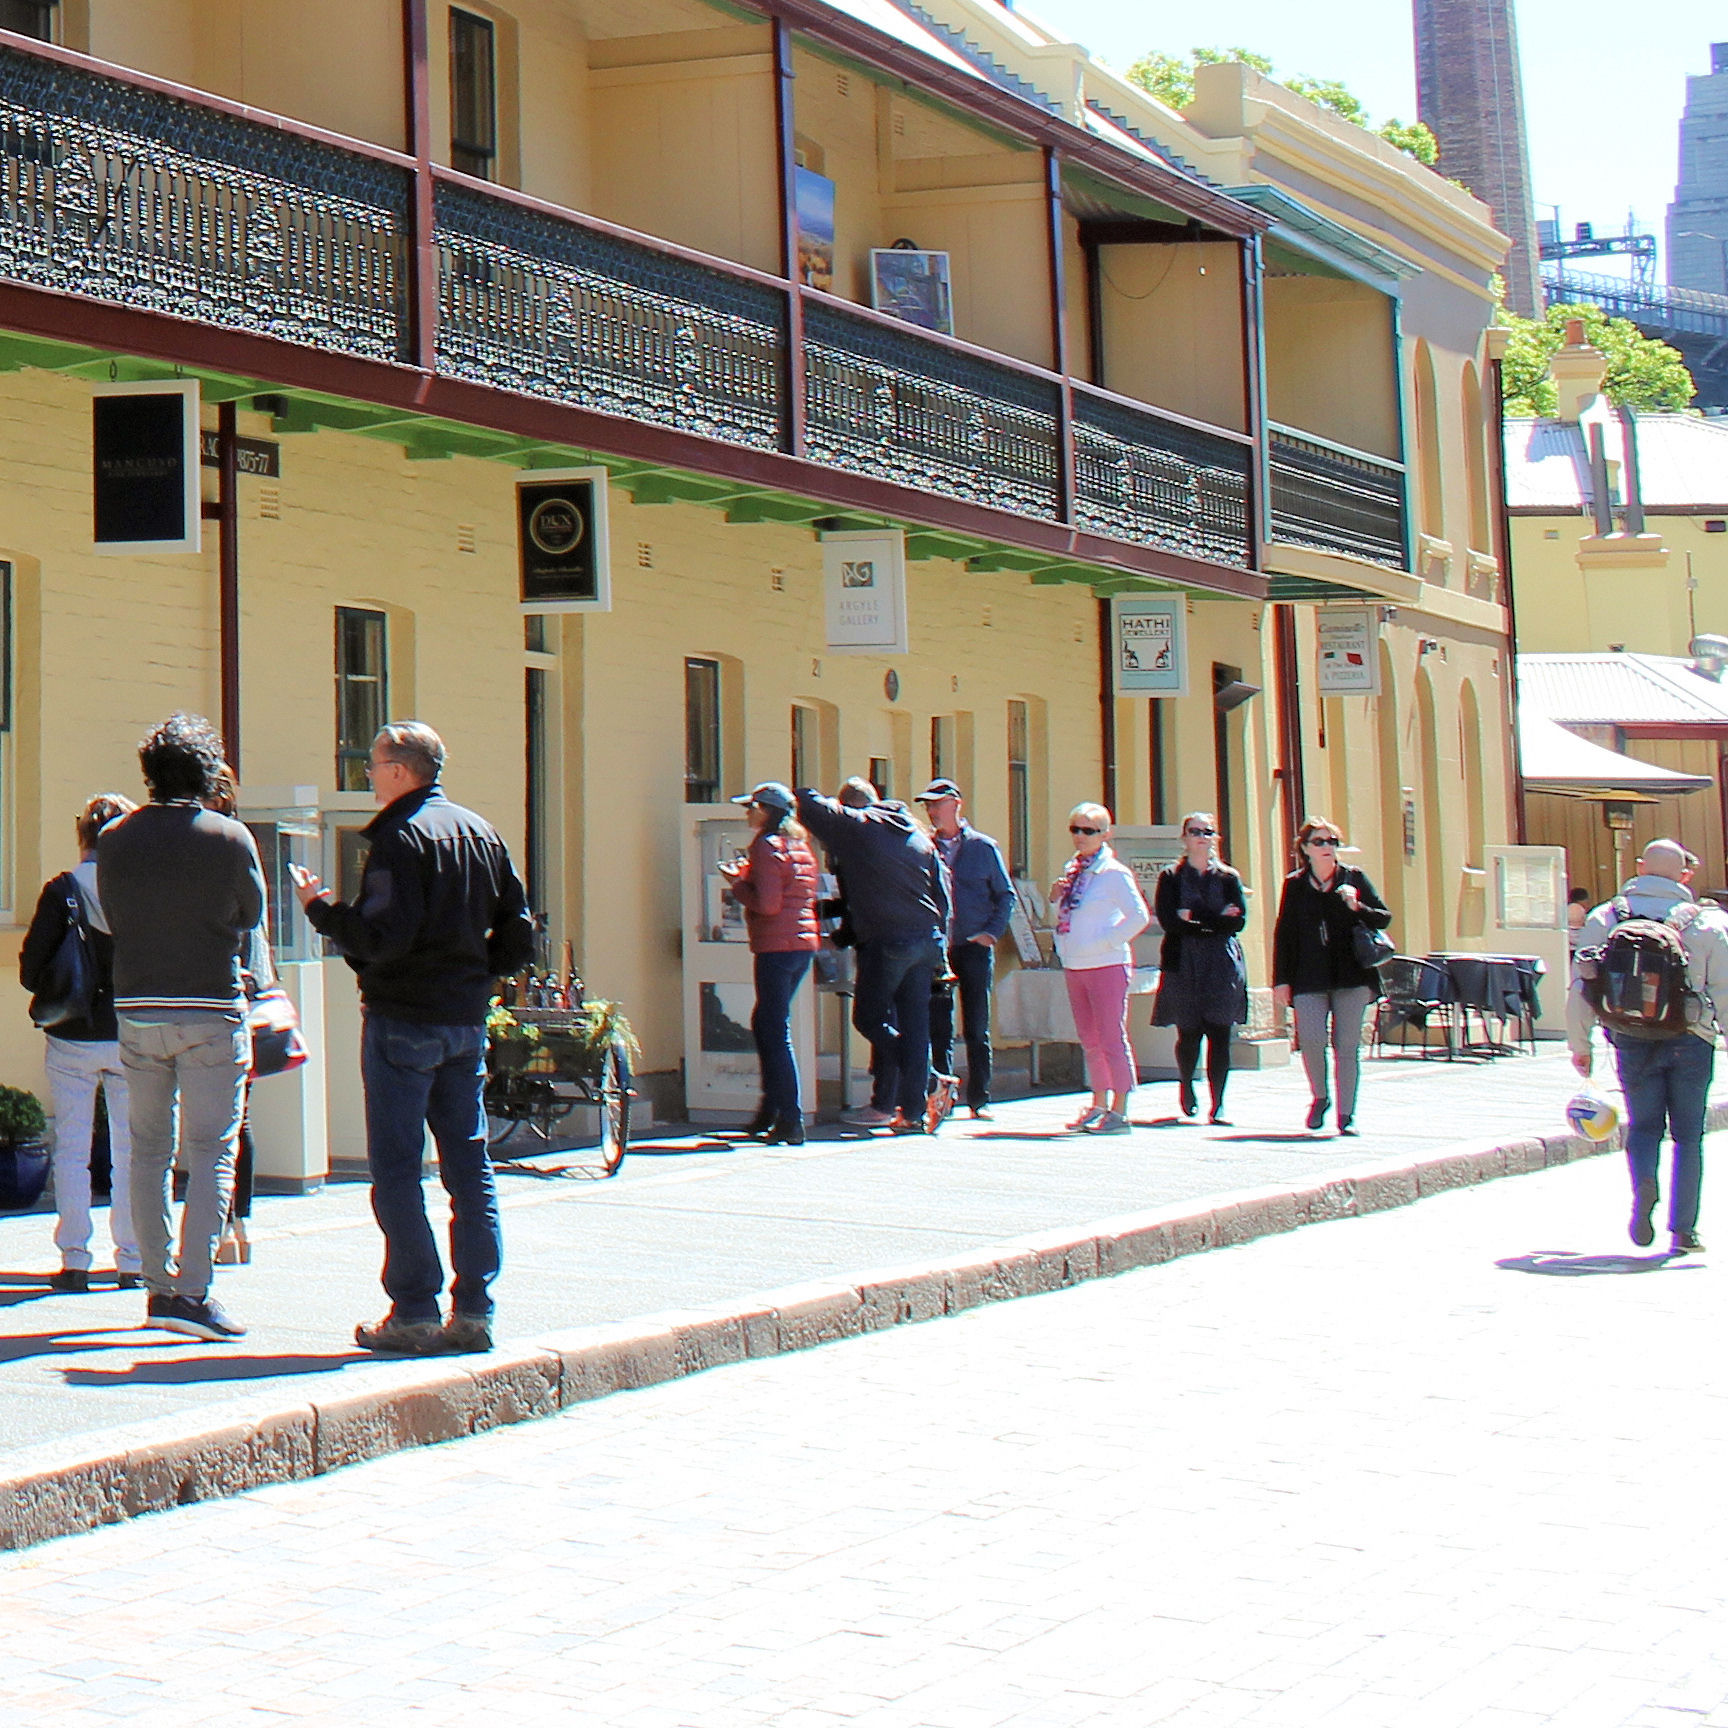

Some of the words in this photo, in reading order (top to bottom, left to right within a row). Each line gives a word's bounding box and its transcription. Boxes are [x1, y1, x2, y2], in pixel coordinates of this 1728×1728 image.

[839, 599, 880, 612] ARGYLE
[839, 614, 879, 626] GALLERY
[1122, 618, 1170, 629] HATHI
